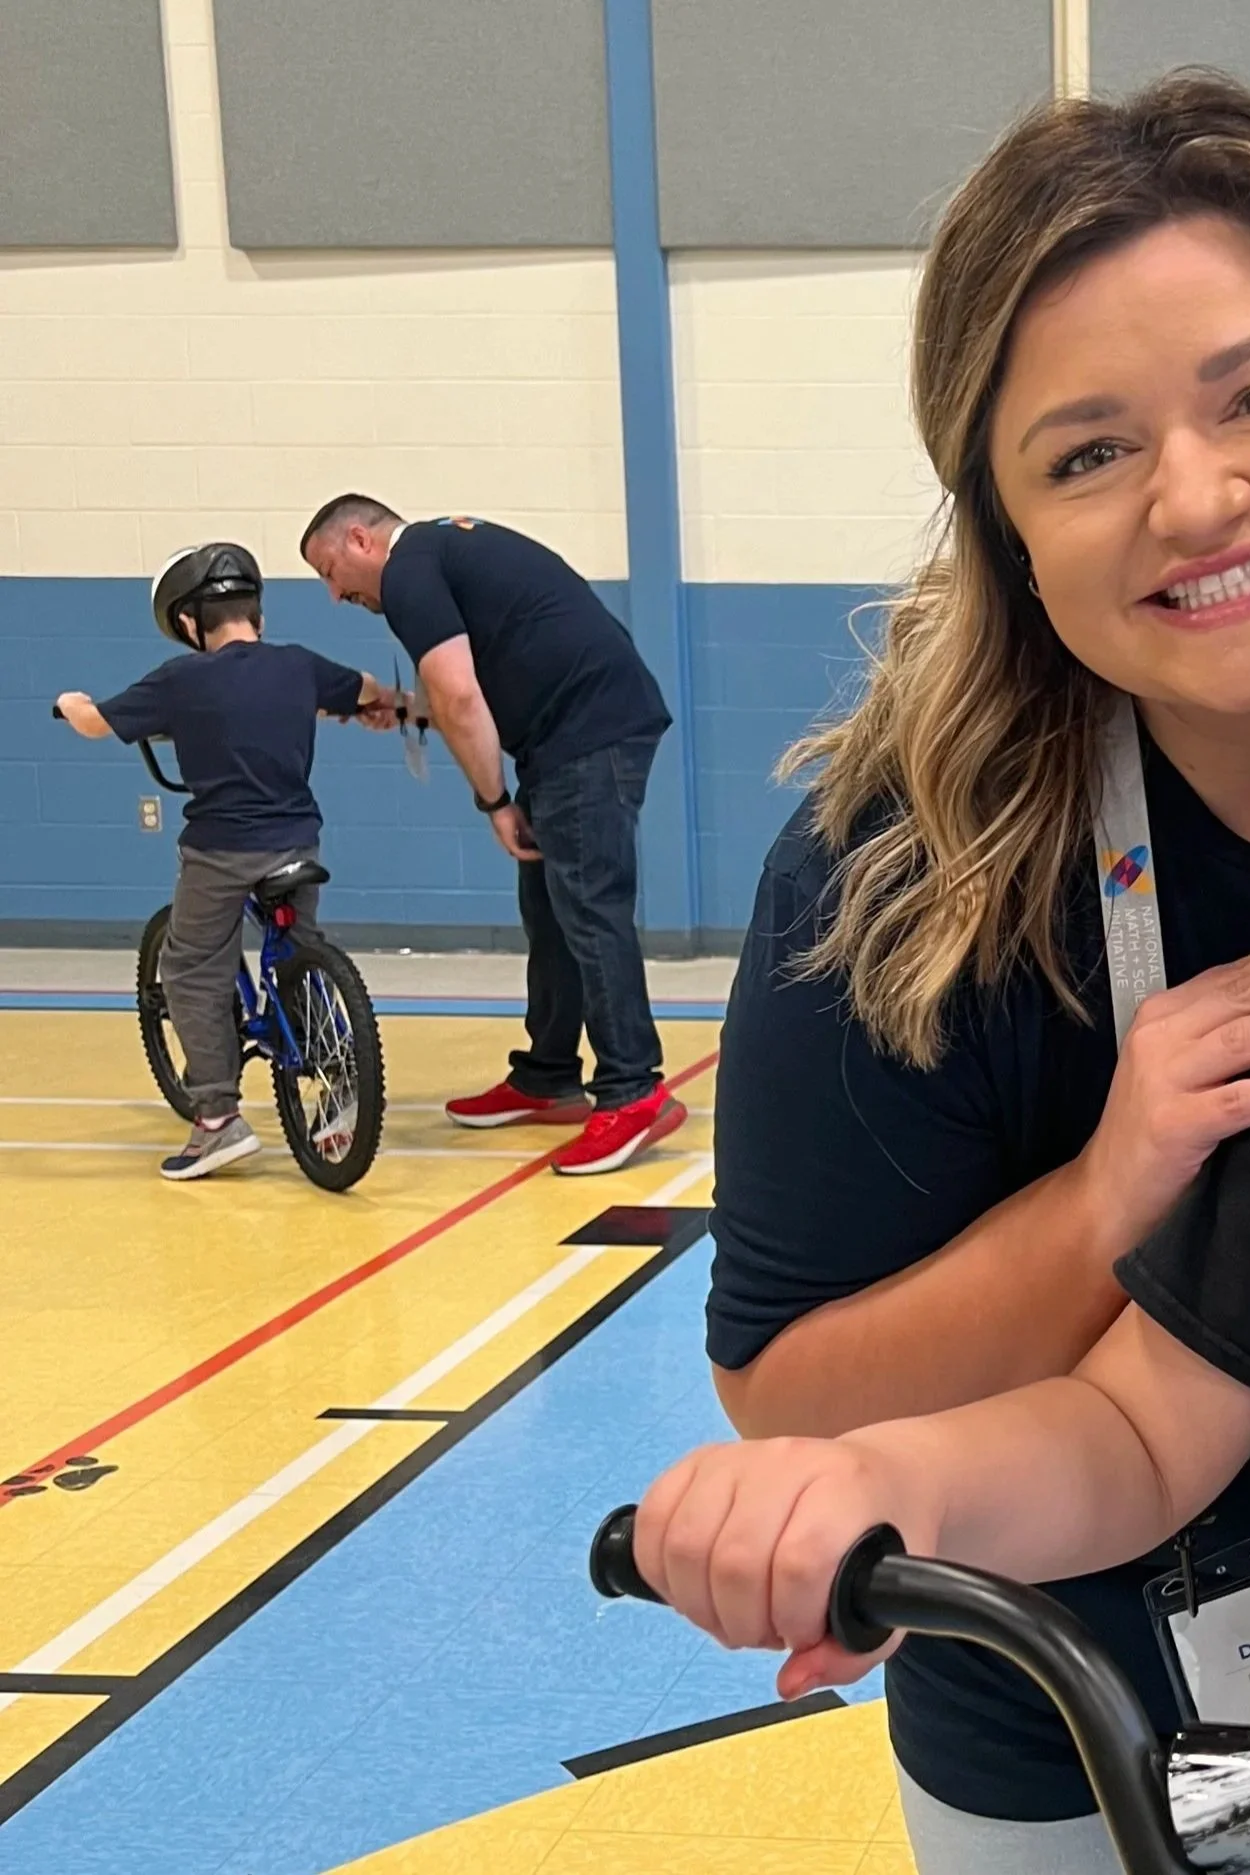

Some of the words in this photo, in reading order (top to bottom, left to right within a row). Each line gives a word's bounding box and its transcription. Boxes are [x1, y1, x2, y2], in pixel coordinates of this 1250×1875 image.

[1109, 909, 1129, 988] INITIATIVE
[1124, 907, 1140, 951] MATH
[1141, 905, 1160, 984] NATIONAL
